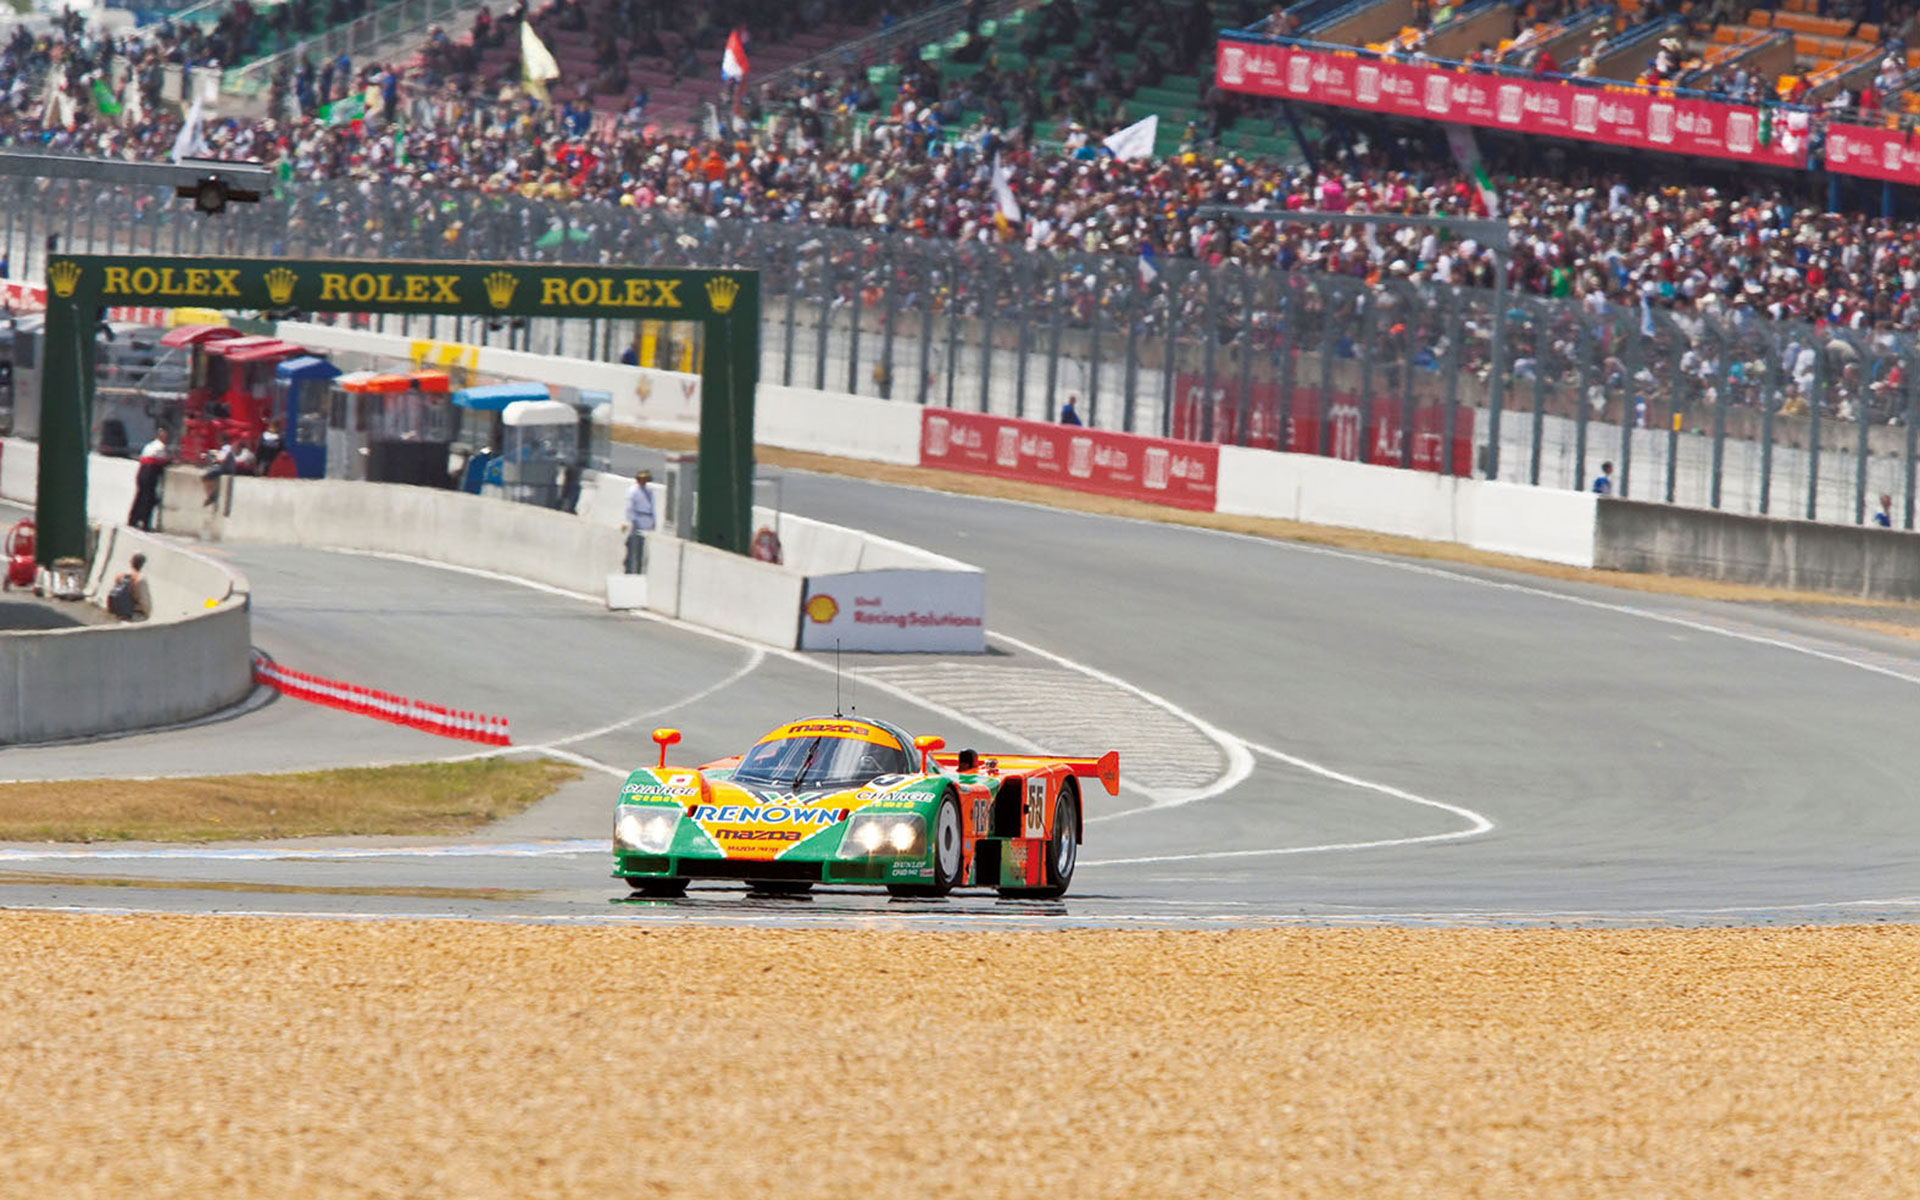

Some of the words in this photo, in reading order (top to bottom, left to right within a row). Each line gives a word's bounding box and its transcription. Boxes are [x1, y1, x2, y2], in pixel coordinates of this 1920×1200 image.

[104, 266, 241, 296] ROLEX
[320, 273, 461, 303] ROLEX
[540, 278, 682, 308] ROLEX
[854, 610, 907, 628] Racing
[908, 611, 982, 627] Solutions
[623, 784, 699, 796] CHARGE
[856, 790, 936, 803] CHARGE
[694, 805, 841, 824] RENOWN
[1028, 785, 1043, 829] 55
